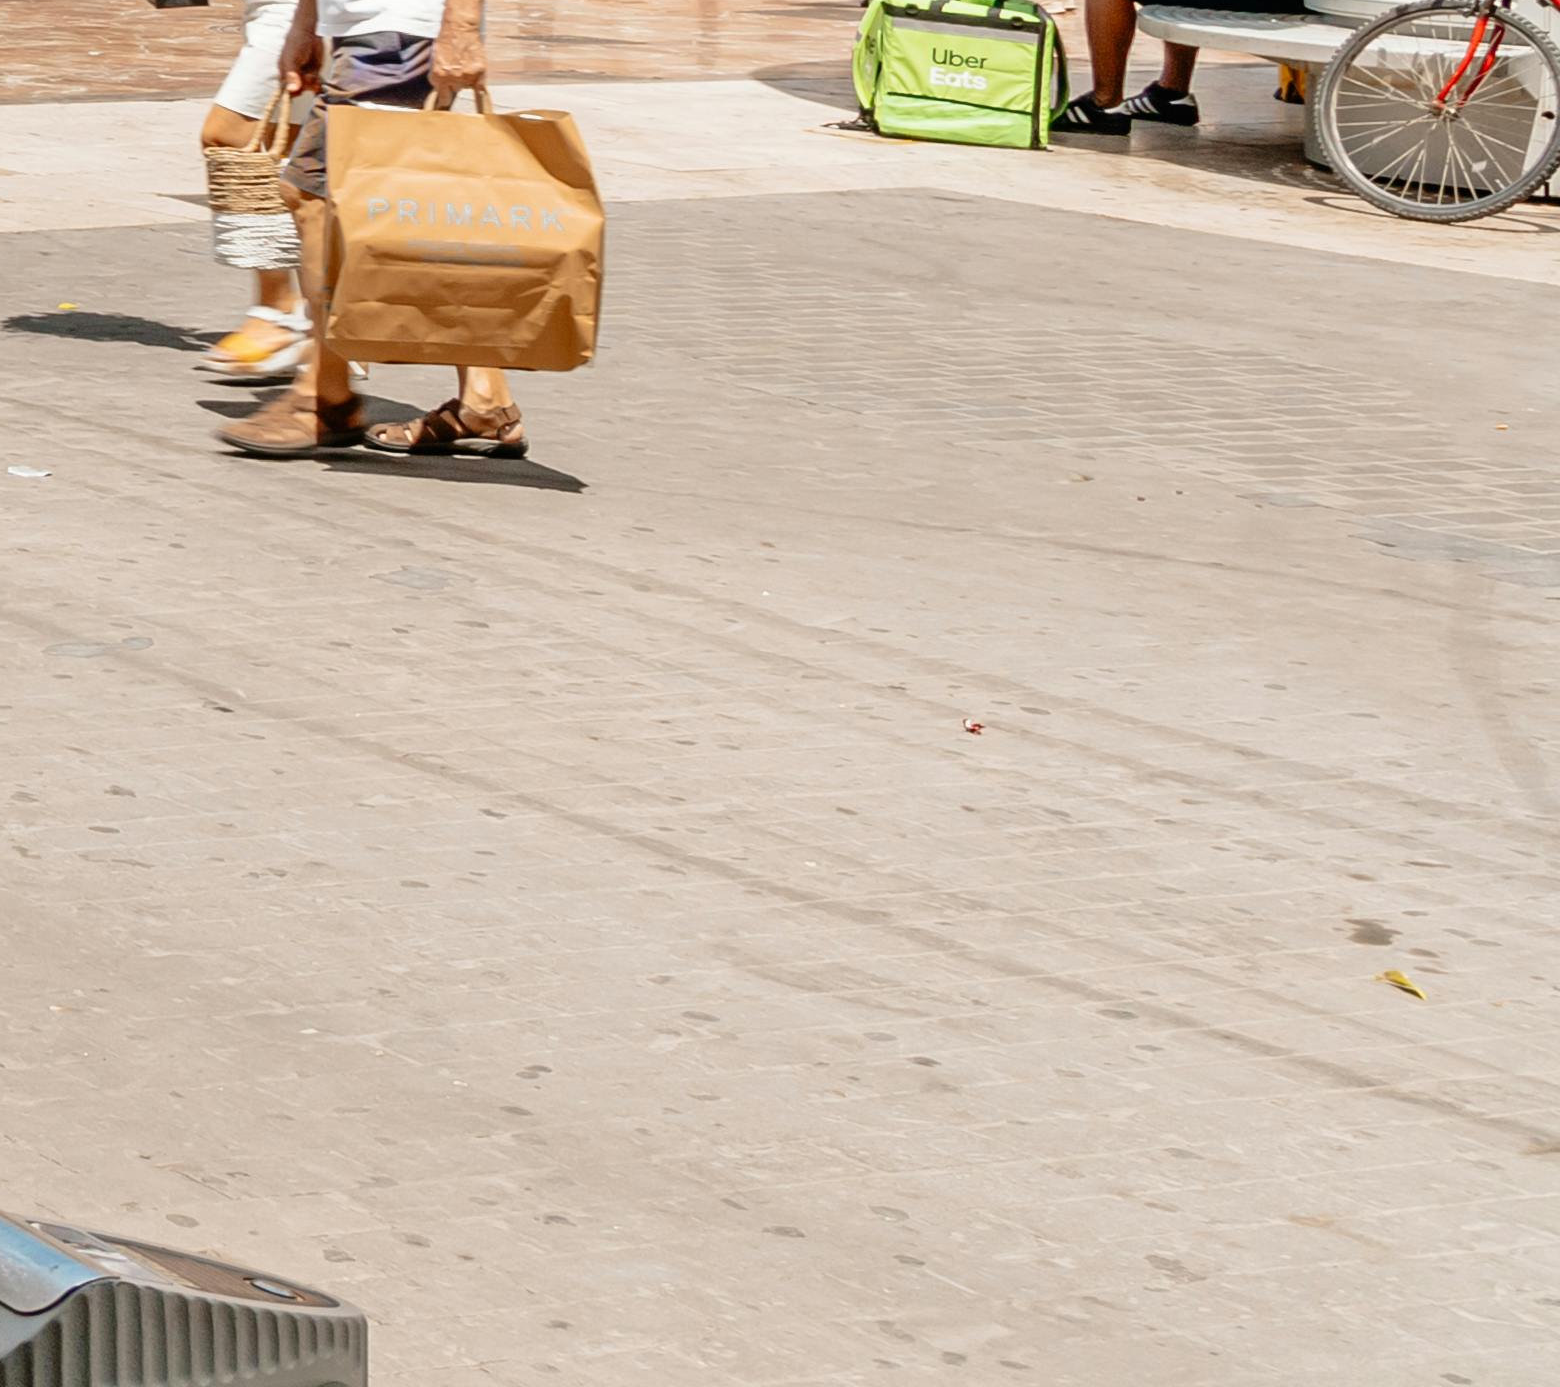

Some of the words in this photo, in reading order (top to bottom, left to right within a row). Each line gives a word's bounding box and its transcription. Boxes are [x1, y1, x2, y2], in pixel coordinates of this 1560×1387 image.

[932, 47, 988, 69] Uber
[929, 67, 987, 91] Eats
[366, 198, 566, 232] PRIMARK
